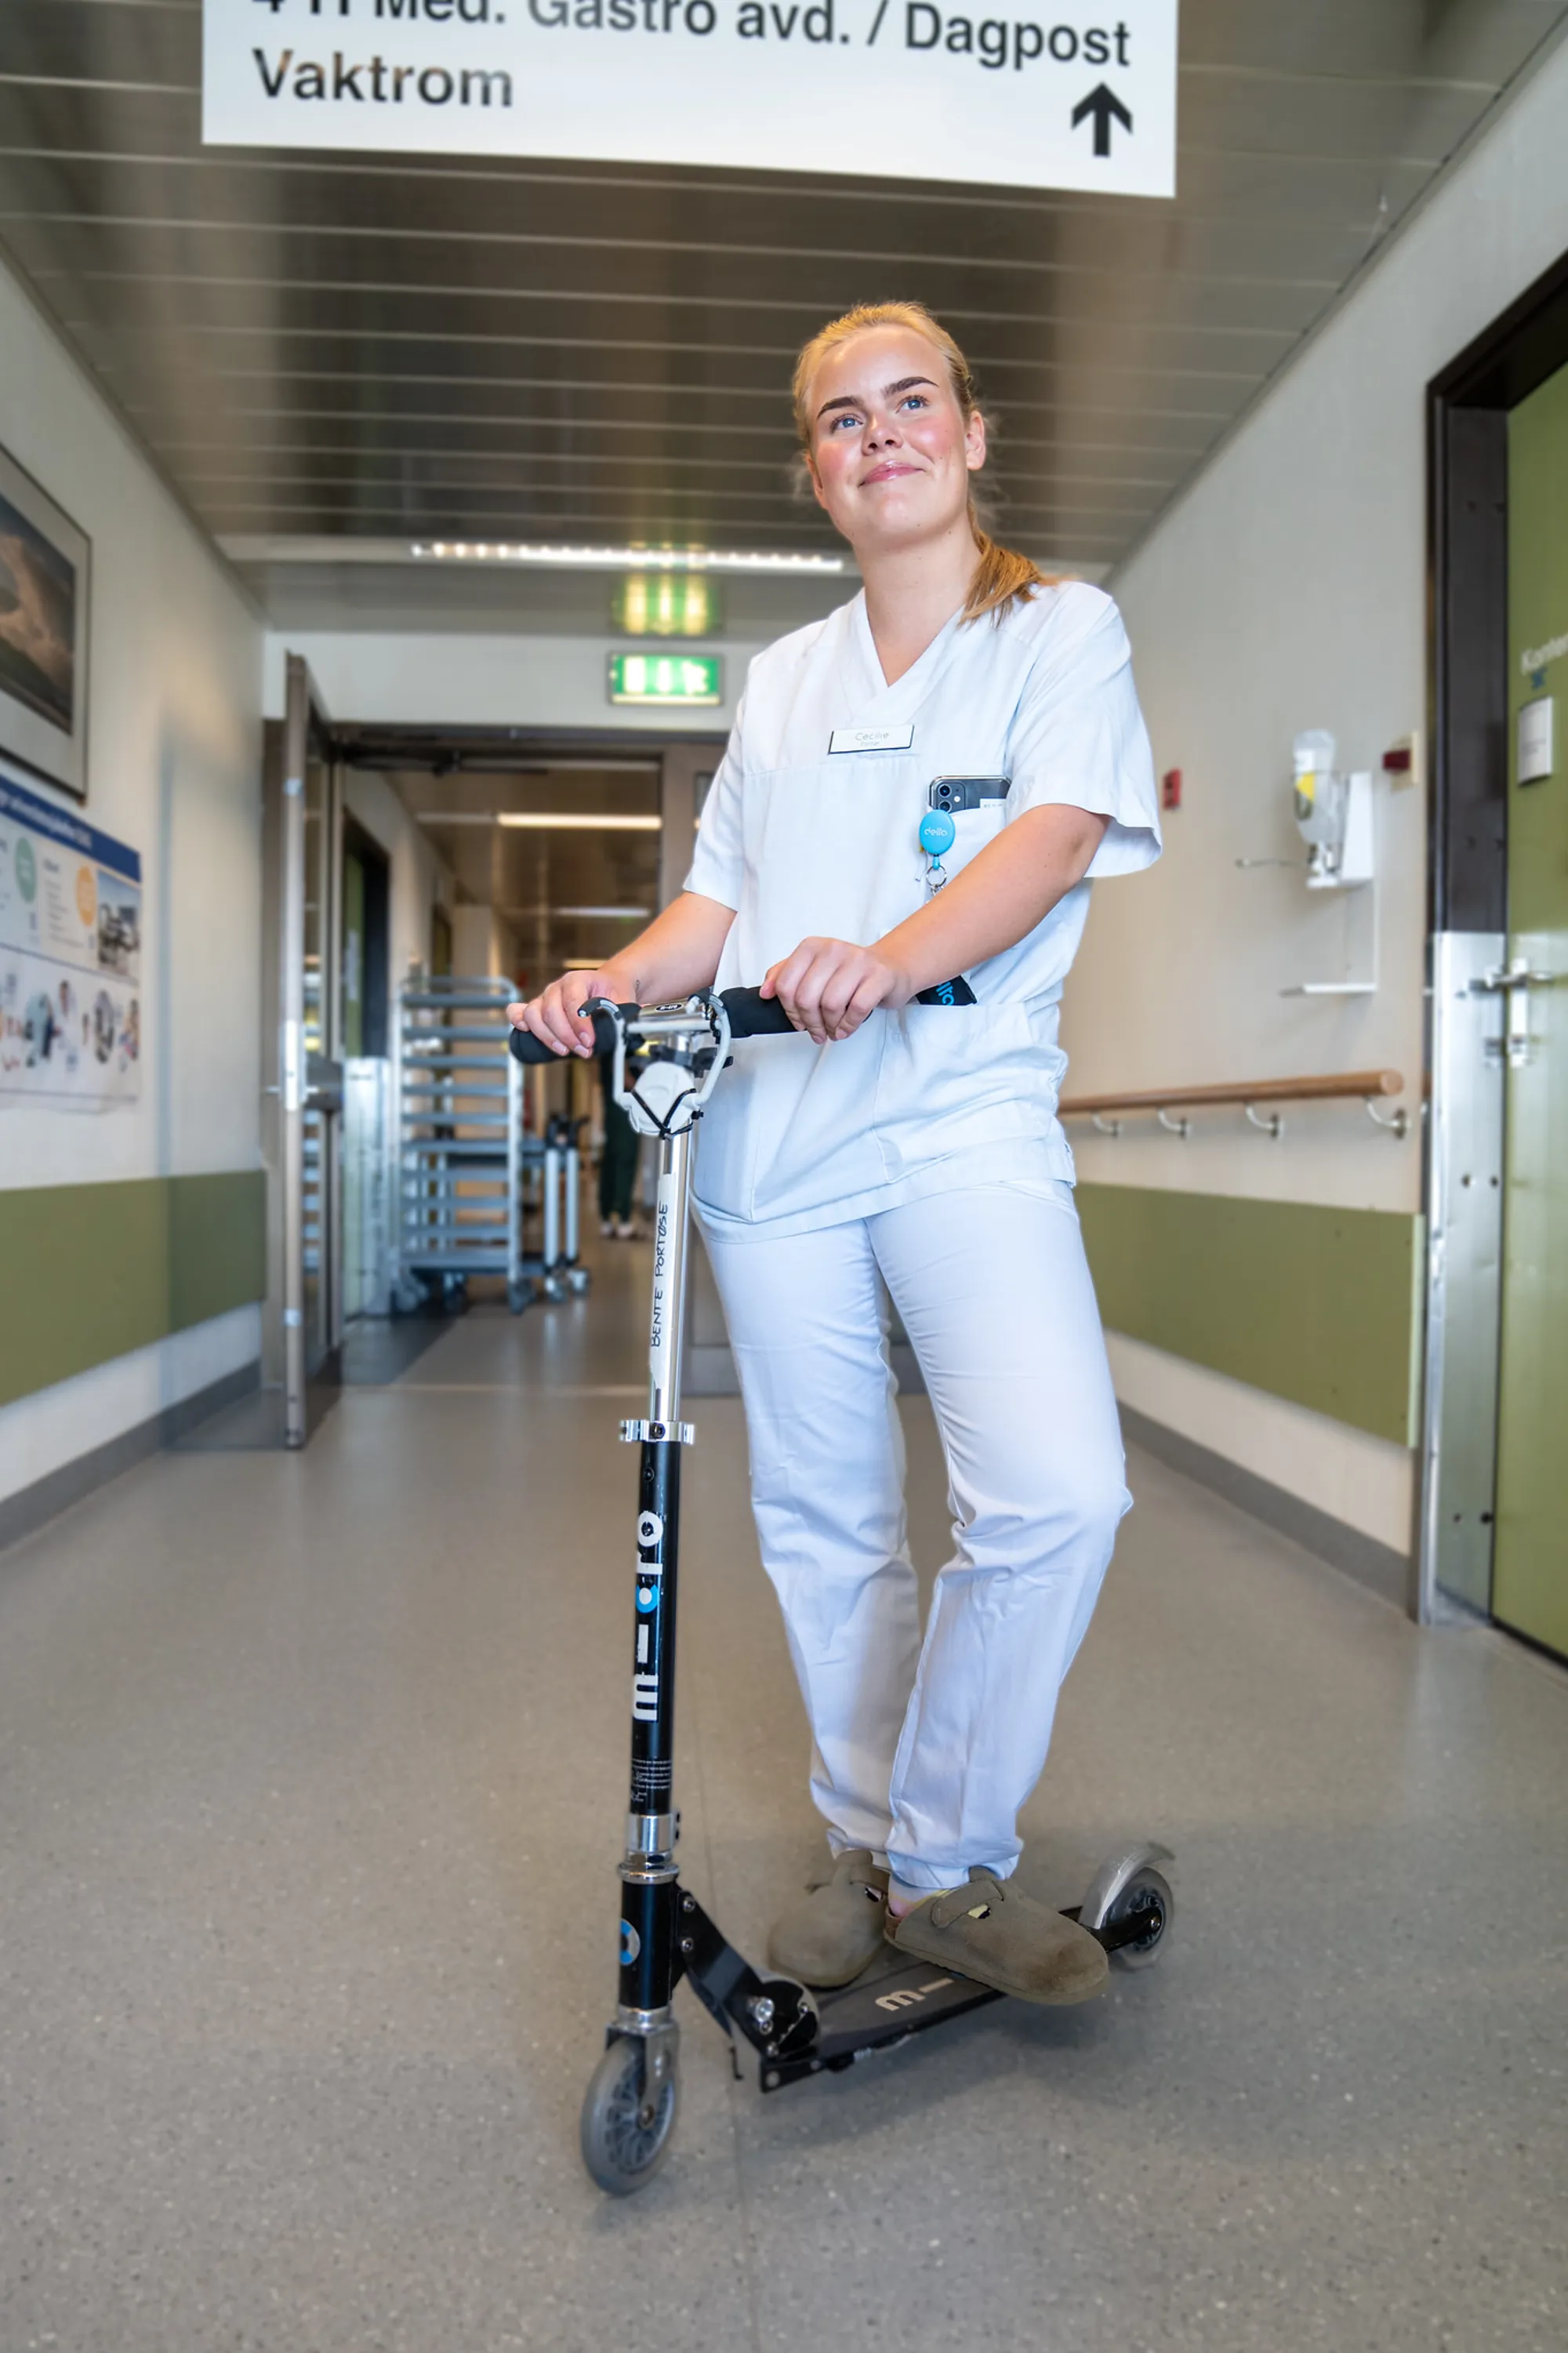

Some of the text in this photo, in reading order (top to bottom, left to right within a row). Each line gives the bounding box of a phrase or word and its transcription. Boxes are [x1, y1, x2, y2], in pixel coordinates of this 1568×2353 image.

[528, 0, 717, 36] Gastro
[736, 0, 850, 45] avd.
[905, 1, 1131, 71] Dagpost
[252, 47, 514, 108] Vaktrom
[651, 1286, 663, 1348] BENTE
